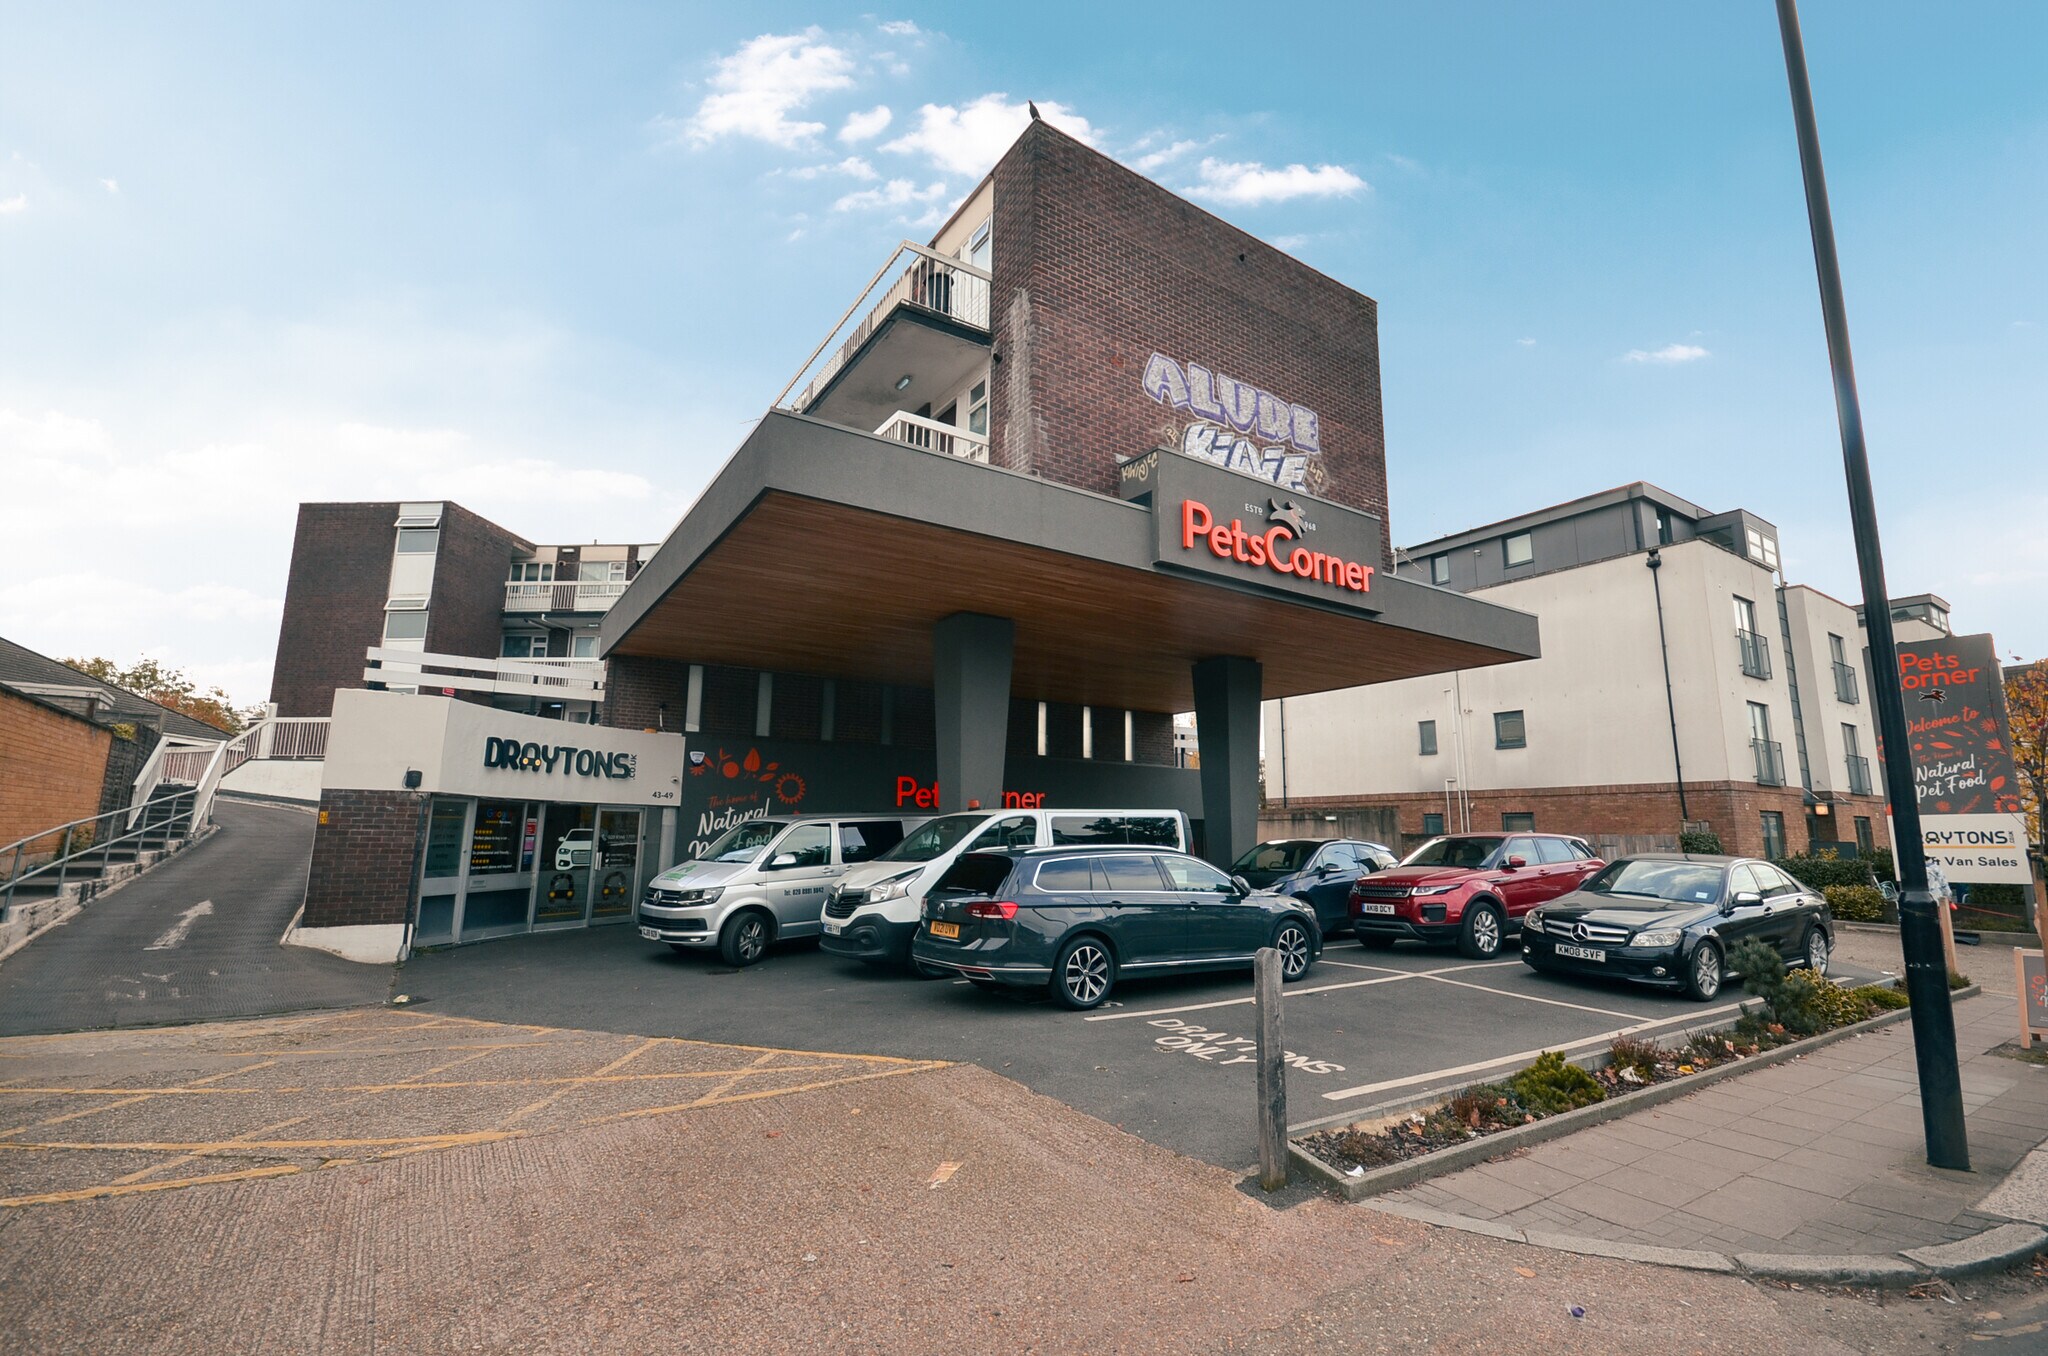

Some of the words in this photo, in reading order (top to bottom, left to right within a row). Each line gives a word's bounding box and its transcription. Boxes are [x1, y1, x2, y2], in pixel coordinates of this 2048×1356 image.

[1303, 521, 1317, 531] 968
[1182, 499, 1375, 593] PetsCorner
[1898, 652, 1960, 674] Pets
[1898, 668, 1980, 691] orner
[1962, 705, 1980, 722] to
[484, 736, 631, 779] DRAYTONS
[1916, 753, 1975, 782] Natural
[652, 791, 674, 800] 43-49
[1915, 781, 1944, 804] Pet
[1945, 769, 1987, 794] Food
[697, 797, 770, 837] Natural
[1923, 831, 2008, 844] AYTONS
[1944, 856, 1973, 866] Van
[1977, 856, 2018, 867] Sales
[1558, 945, 1581, 957] KM08
[1582, 949, 1601, 960] SVF
[1155, 1036, 1257, 1065] ONLY
